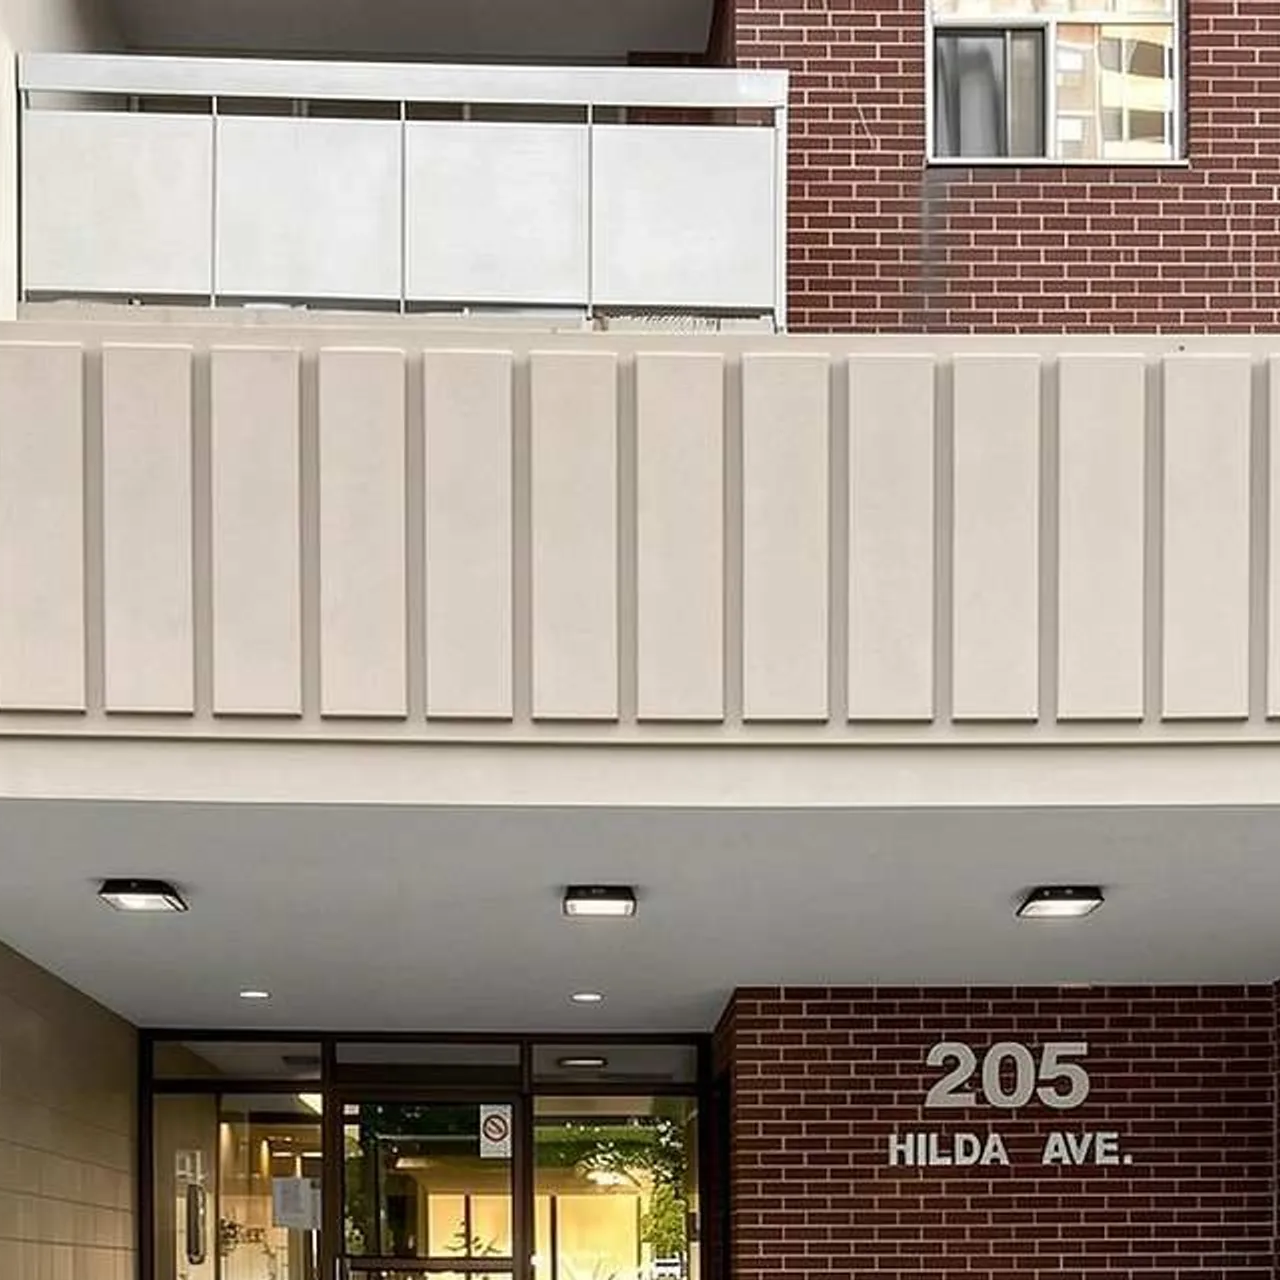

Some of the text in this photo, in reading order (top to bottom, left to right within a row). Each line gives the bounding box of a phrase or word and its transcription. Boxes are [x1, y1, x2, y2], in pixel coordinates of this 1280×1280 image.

[924, 1042, 1090, 1108] 205
[888, 1133, 1132, 1165] HILDA AVE.
